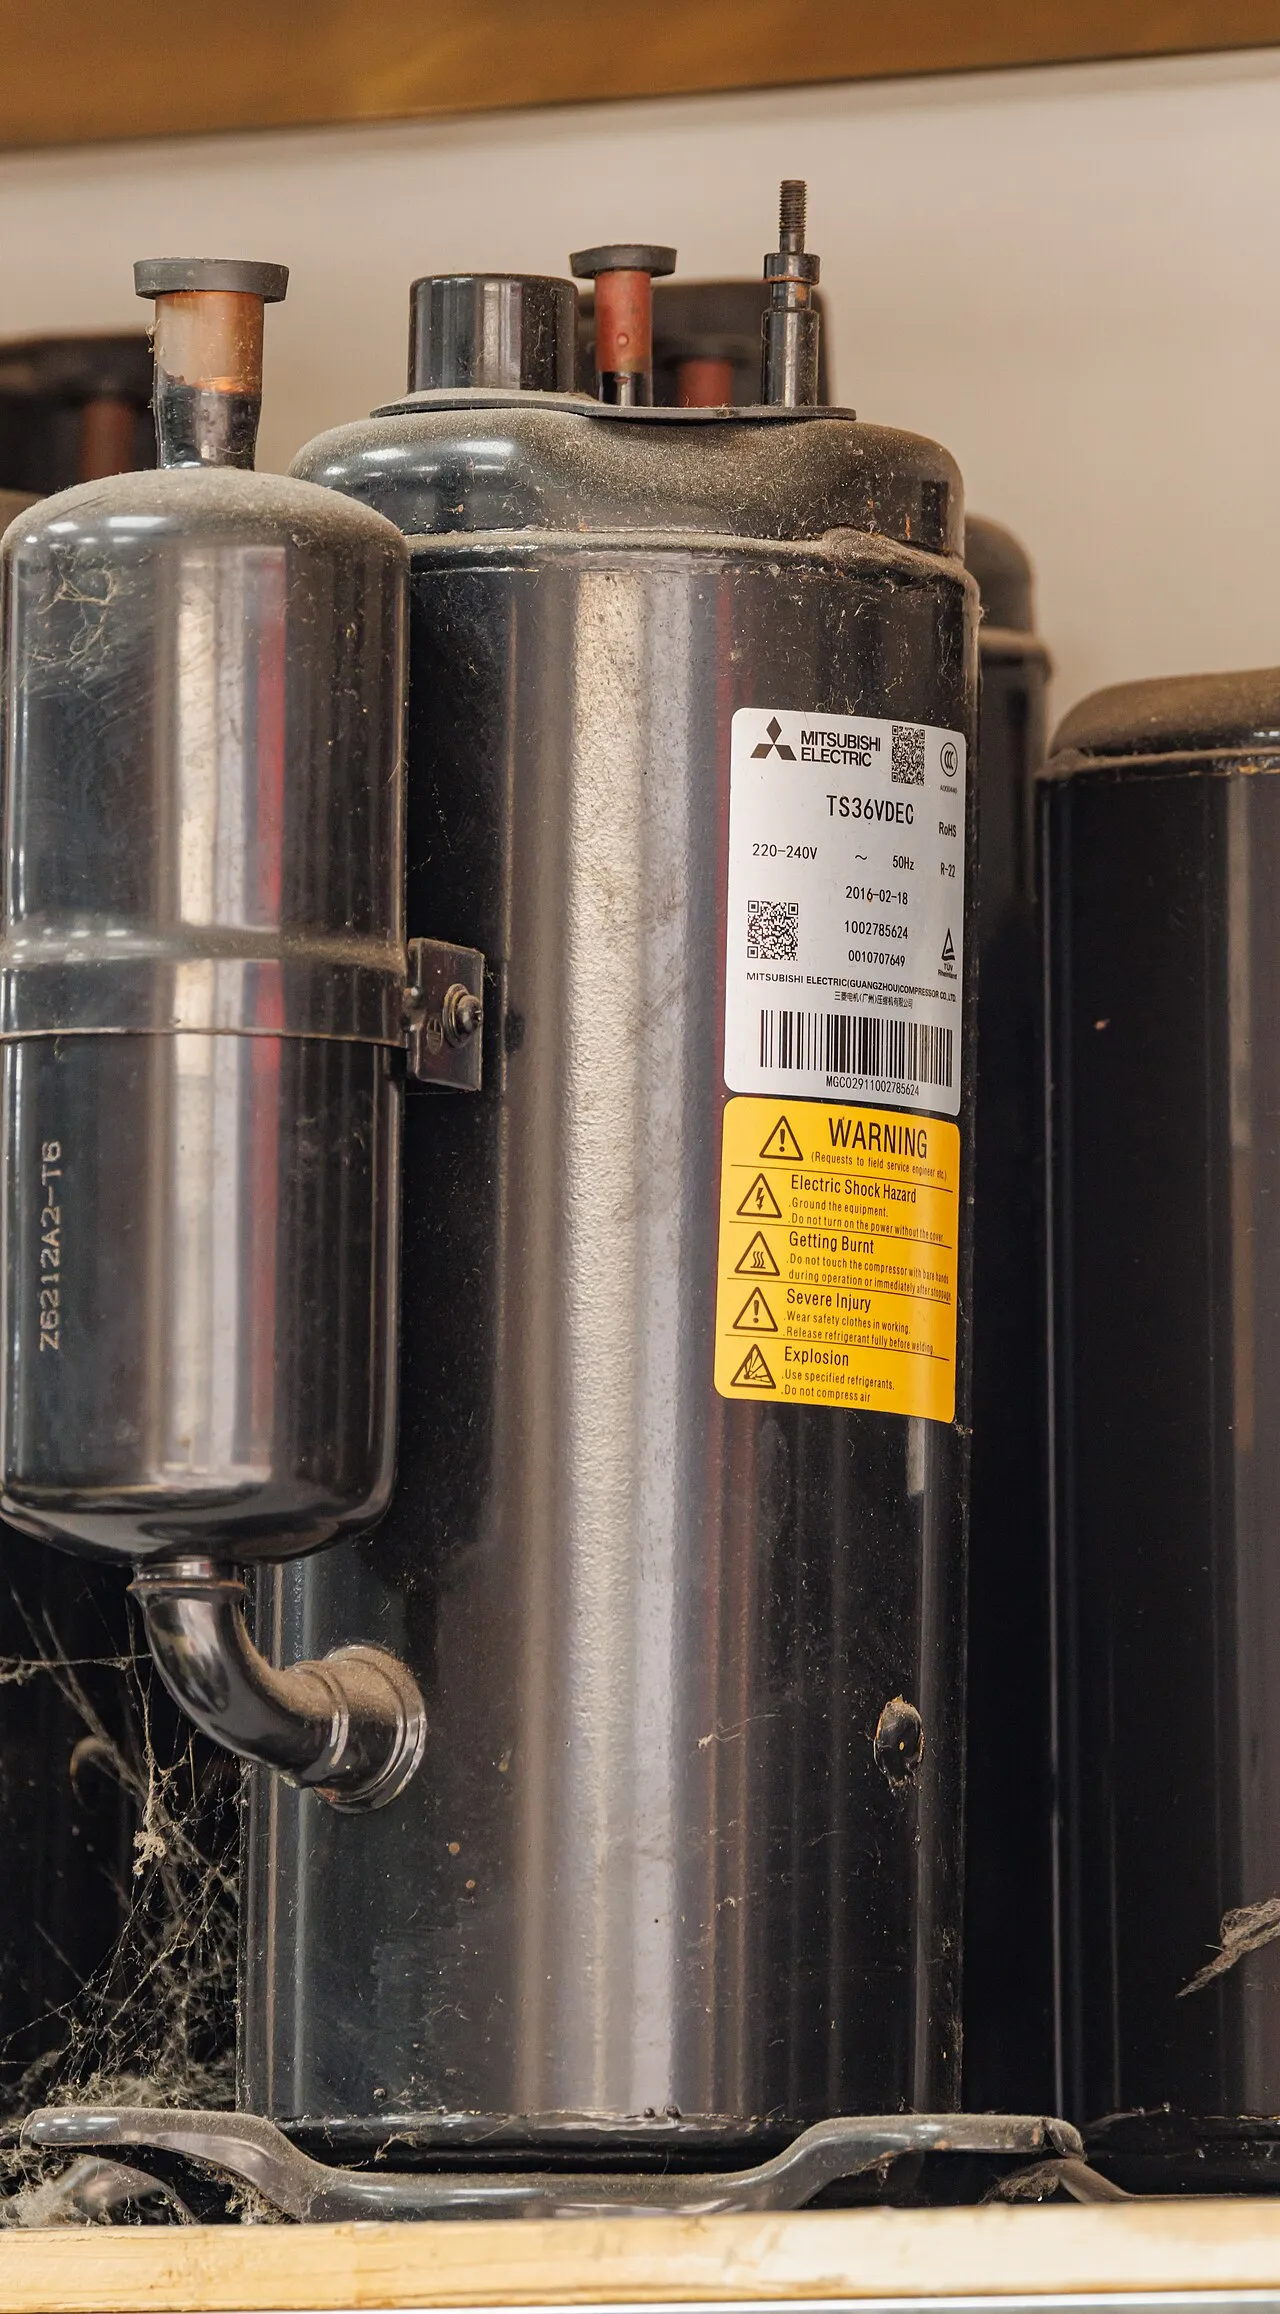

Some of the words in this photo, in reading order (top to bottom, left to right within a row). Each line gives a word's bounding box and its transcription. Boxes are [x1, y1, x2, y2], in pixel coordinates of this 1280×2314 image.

[800, 730, 881, 752] MITSUBISHI
[800, 747, 872, 767] ELECTRIC
[826, 794, 914, 825] TS36VDEC
[939, 821, 957, 838] RoHS
[752, 843, 818, 860] 220-240V
[892, 856, 915, 870] 50Hz
[940, 862, 956, 878] R-22
[845, 886, 908, 905] 2016-02-18
[844, 920, 908, 940] 1002785624
[848, 950, 906, 967] 0010707649
[746, 972, 804, 984] MITSUBISHI
[828, 1117, 928, 1160] WARNING
[811, 1151, 853, 1165] (Requests
[856, 1157, 864, 1167] to
[868, 1158, 884, 1169] field
[886, 1161, 910, 1173] service
[912, 1165, 935, 1178] engineer
[791, 1174, 841, 1193] Electric
[844, 1179, 880, 1198] Shock
[883, 1184, 917, 1204] Hazard
[828, 1200, 842, 1212] the
[844, 1204, 888, 1218] equipment.
[806, 1214, 822, 1226] not
[824, 1216, 842, 1228] turn
[844, 1219, 854, 1229] on
[856, 1220, 868, 1231] the
[870, 1223, 893, 1234] power
[894, 1224, 920, 1238] without
[920, 1228, 929, 1239] the
[40, 1140, 63, 1352] Z6212A2-T6
[789, 1230, 838, 1252] Getting
[842, 1236, 874, 1254] Burnt
[805, 1255, 820, 1266] not
[822, 1256, 847, 1269] touch
[850, 1259, 862, 1270] the
[864, 1262, 908, 1277] compressor
[909, 1266, 922, 1279] with
[922, 1269, 935, 1282] bare
[936, 1271, 949, 1284] hands
[788, 1269, 819, 1282] during
[822, 1272, 862, 1286] operation
[864, 1278, 873, 1287] or
[874, 1276, 916, 1295] immediately
[916, 1284, 930, 1295] after
[786, 1288, 832, 1306] Severe
[836, 1292, 872, 1314] Injury
[812, 1312, 840, 1327] safety
[842, 1316, 872, 1329] clothes
[873, 1318, 880, 1330] in
[882, 1320, 911, 1336] working.
[824, 1330, 870, 1345] refrigerant
[871, 1334, 888, 1348] fully
[890, 1336, 910, 1350] before
[784, 1346, 849, 1366] Explosion
[805, 1371, 845, 1384] specified
[848, 1374, 895, 1391] refrigerants.
[800, 1386, 815, 1397] not
[816, 1388, 858, 1401] compress
[860, 1391, 870, 1402] air
